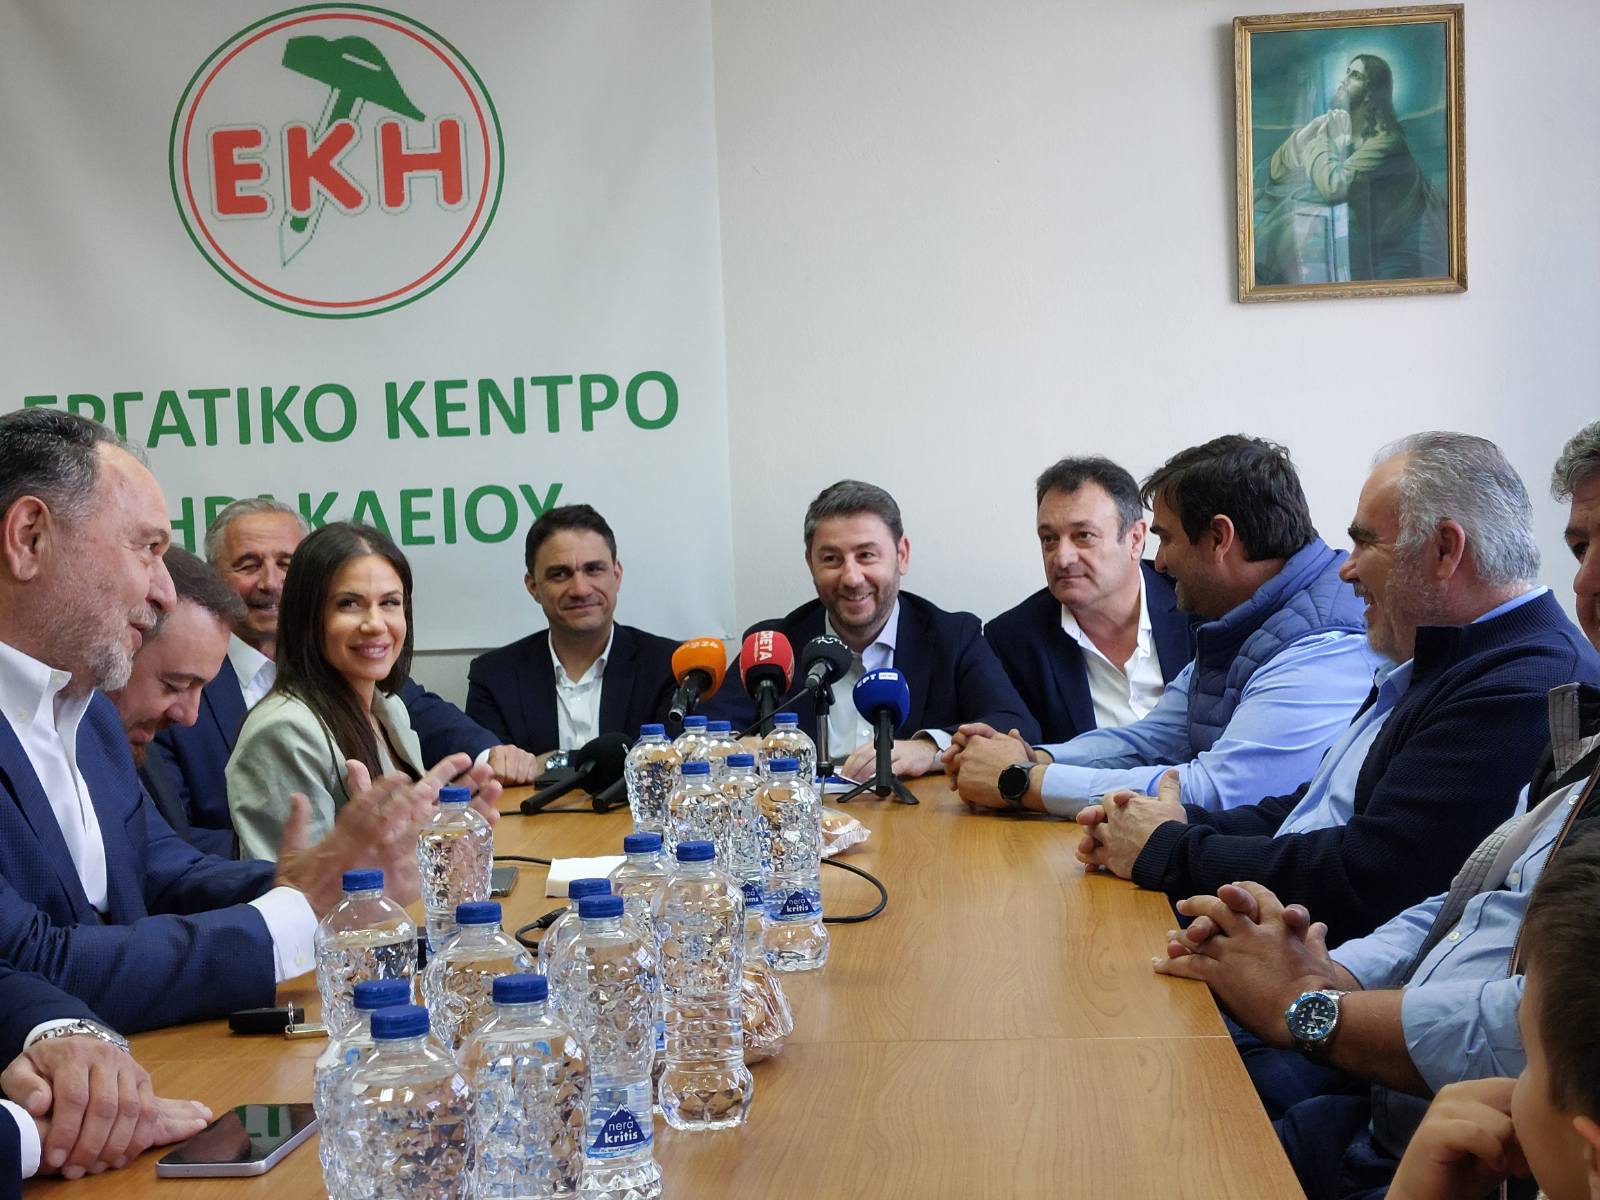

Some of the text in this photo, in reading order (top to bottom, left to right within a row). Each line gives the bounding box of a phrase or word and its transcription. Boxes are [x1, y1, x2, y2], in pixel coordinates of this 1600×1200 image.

[211, 117, 465, 216] ΕΚΗ
[24, 370, 680, 448] ΡΓΑΤΙΚΟ ΚΕΝΤΡΟ
[786, 903, 809, 913] kritis
[604, 1130, 638, 1144] kritis
